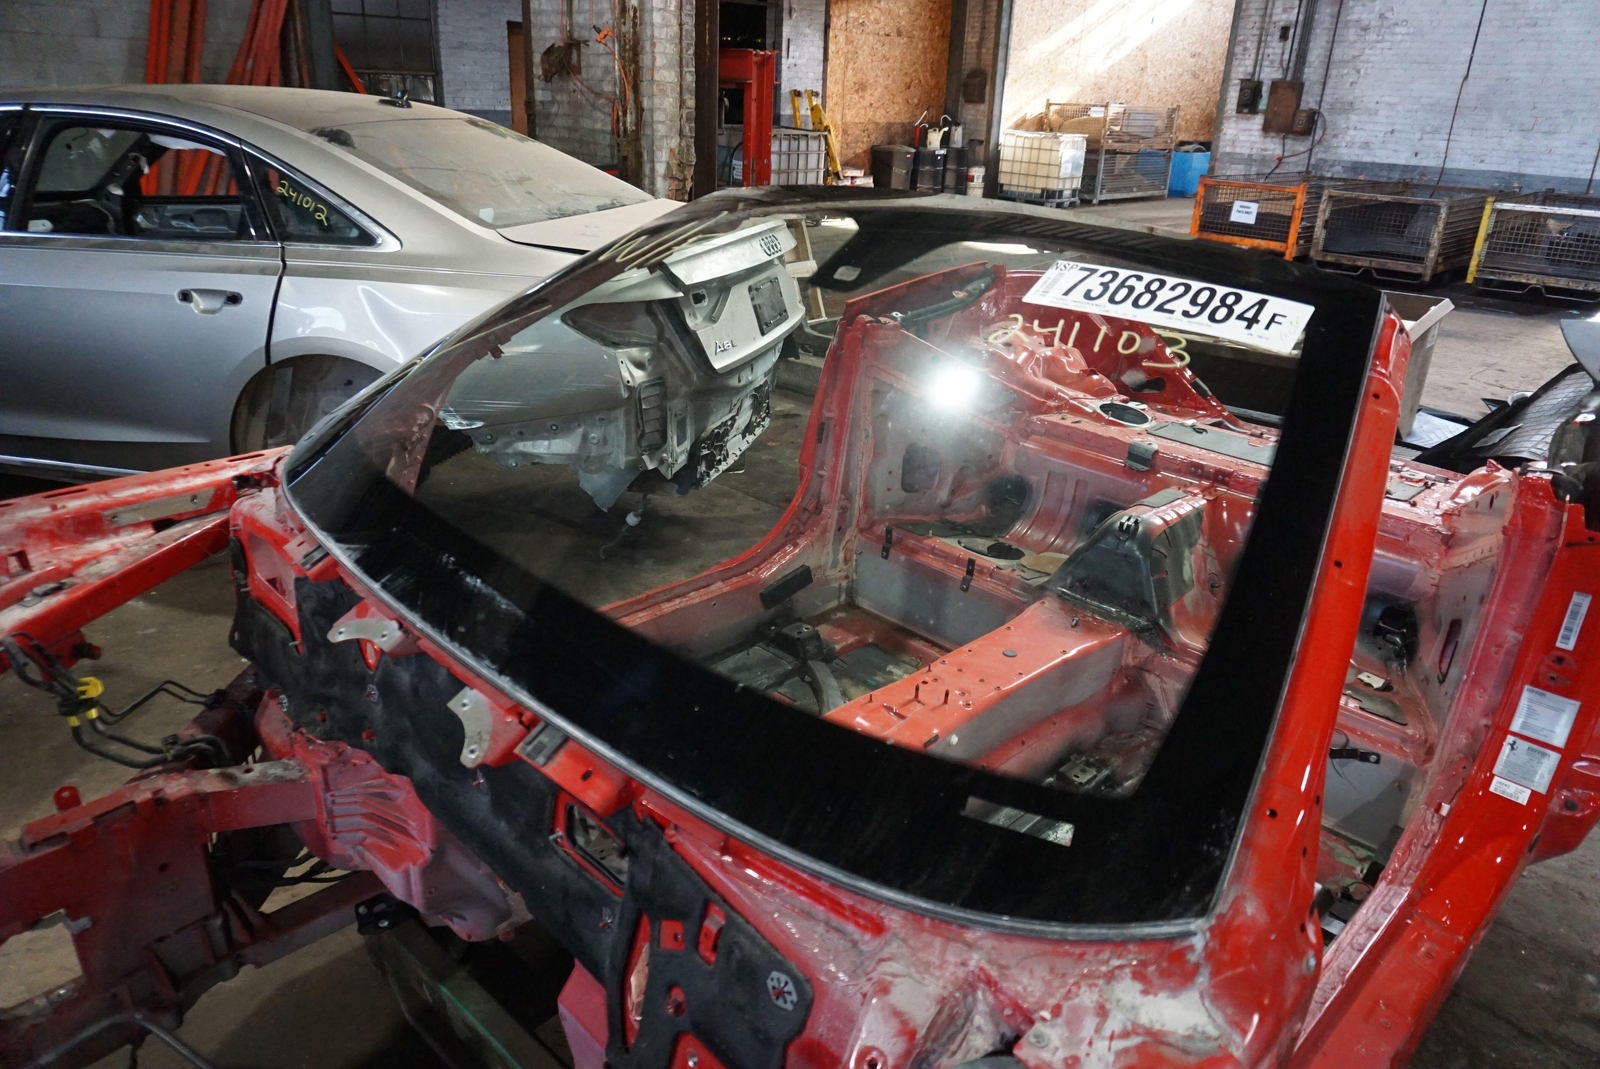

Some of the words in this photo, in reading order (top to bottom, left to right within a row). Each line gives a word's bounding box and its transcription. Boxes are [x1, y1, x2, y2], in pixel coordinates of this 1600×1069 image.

[276, 180, 328, 227] 241012
[1053, 261, 1079, 273] NSP
[1061, 266, 1270, 330] 73682984
[1263, 312, 1288, 331] F
[988, 313, 1192, 369] 241103
